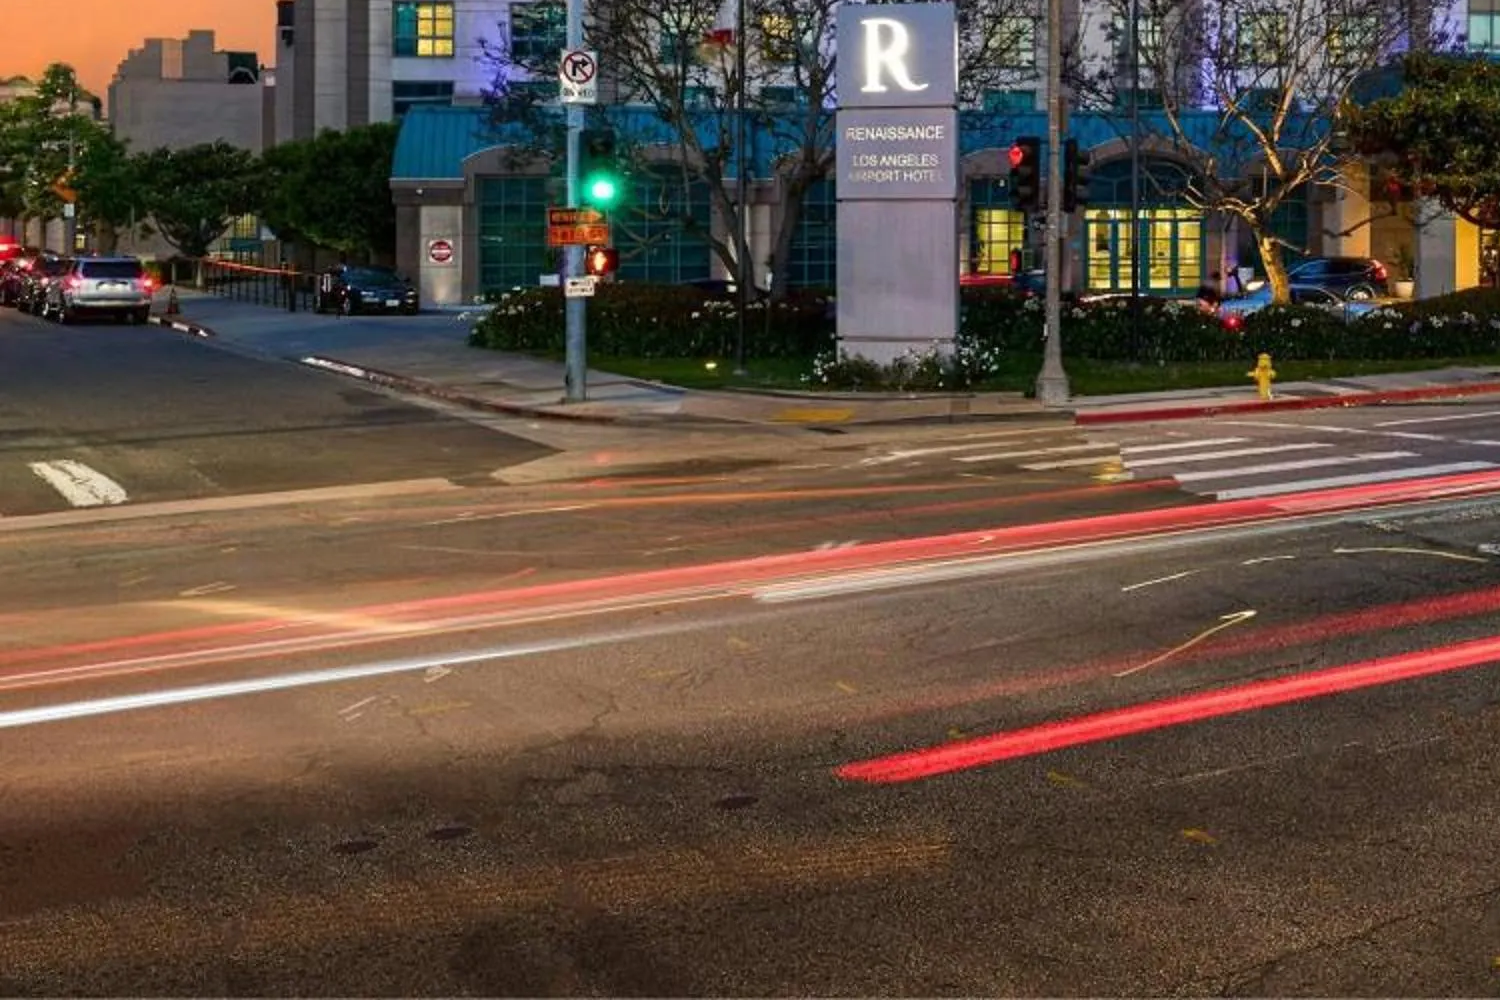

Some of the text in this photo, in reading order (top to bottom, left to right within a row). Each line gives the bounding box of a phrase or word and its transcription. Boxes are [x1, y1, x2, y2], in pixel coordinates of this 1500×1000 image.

[860, 18, 929, 93] R
[845, 125, 944, 141] RENAISSANCE
[853, 153, 939, 167] LOS ANGELES
